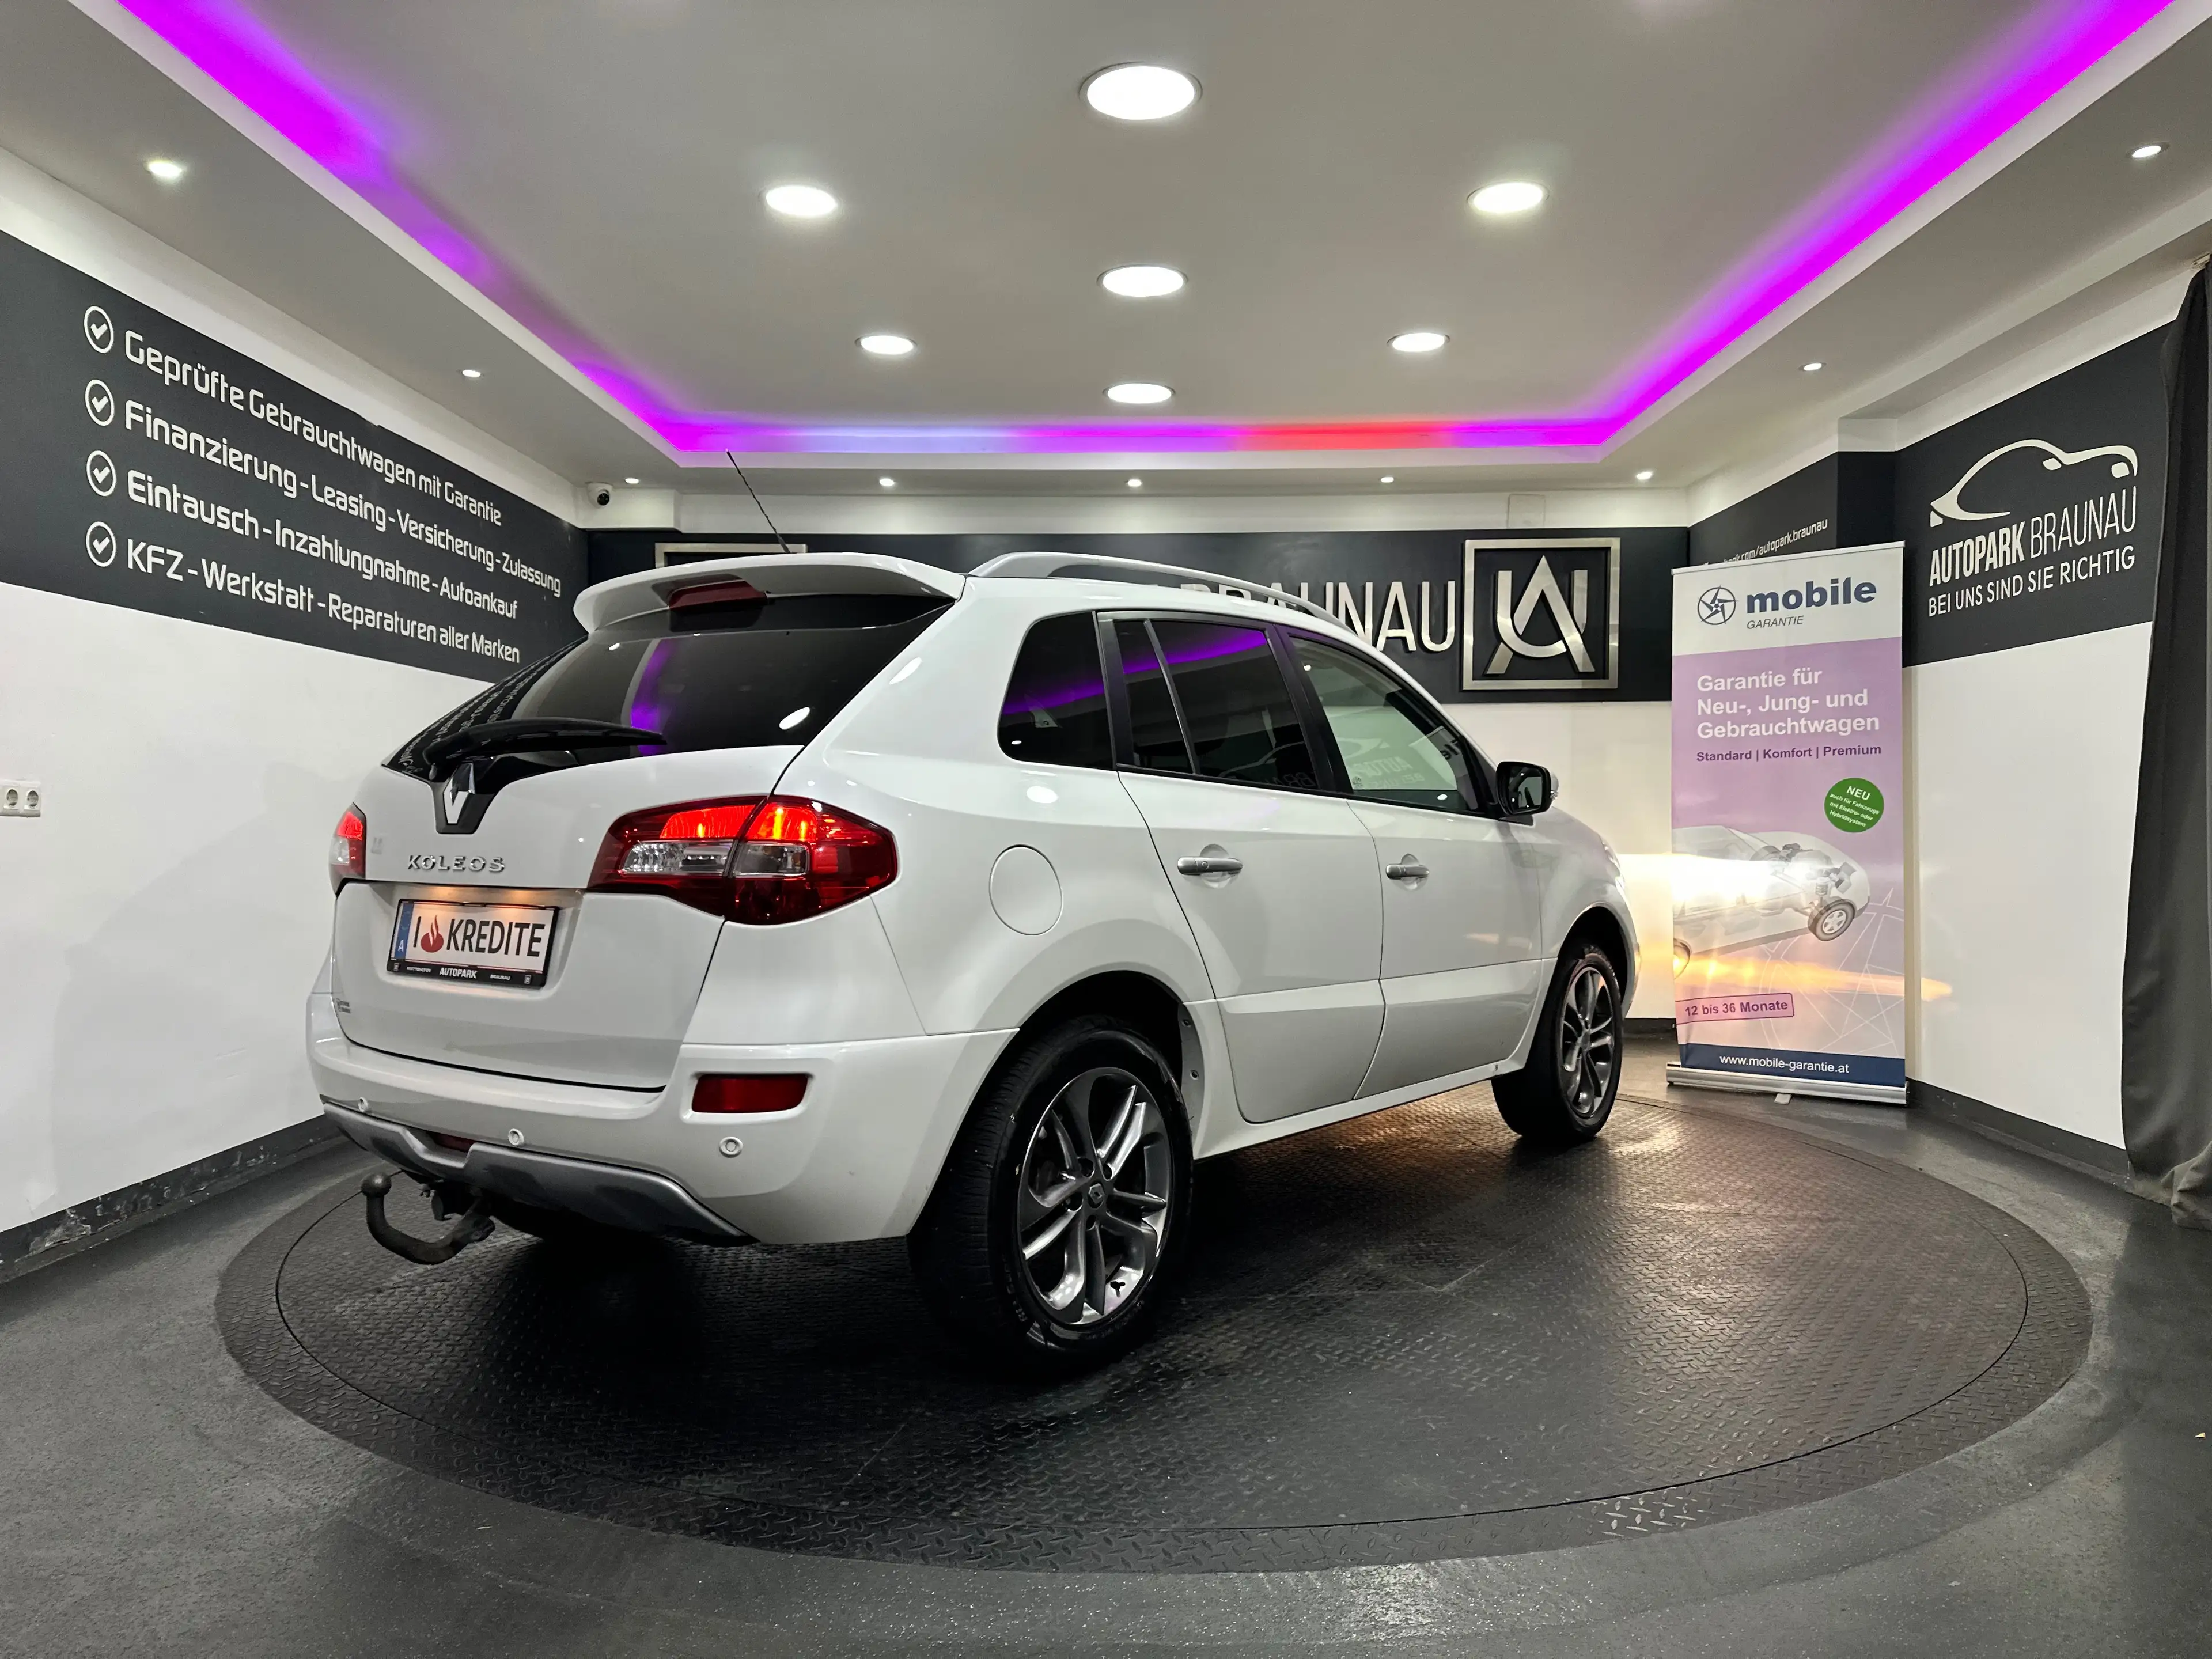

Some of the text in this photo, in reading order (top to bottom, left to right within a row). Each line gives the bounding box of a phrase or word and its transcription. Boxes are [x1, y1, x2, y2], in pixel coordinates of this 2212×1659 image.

[125, 330, 501, 526] Geprüfte Gebrauchtwagen mit Garantie
[1929, 486, 2137, 587] AUTOPARK BRAUNAU
[1929, 545, 2135, 617] BEI UNS SIND SIE RICHTIG
[1747, 577, 1877, 613] mobile
[1747, 615, 1805, 629] GARANTIE
[440, 625, 469, 650] aller
[471, 632, 520, 664] Marken
[1697, 667, 1823, 691] Garantie für
[1698, 688, 1868, 715] Neu-, Jung- und
[1697, 717, 1880, 738] Gebrauchtwagen
[1696, 750, 1752, 762] Standard
[1763, 747, 1813, 759] Komfort
[1823, 745, 1881, 756] Premium
[1846, 786, 1871, 800] NEU
[1830, 793, 1843, 801] auch
[1852, 801, 1880, 815] Fahrzeuge
[1830, 810, 1866, 827] Hybridsystem
[407, 855, 505, 873] KOLEOS
[397, 939, 404, 952] A
[446, 918, 546, 957] KREDITE
[440, 967, 478, 979] AUTOPARK
[1685, 1001, 1788, 1017] 12 bis 36 Monate
[1719, 1056, 1850, 1074] www.mobile-garantie.at
